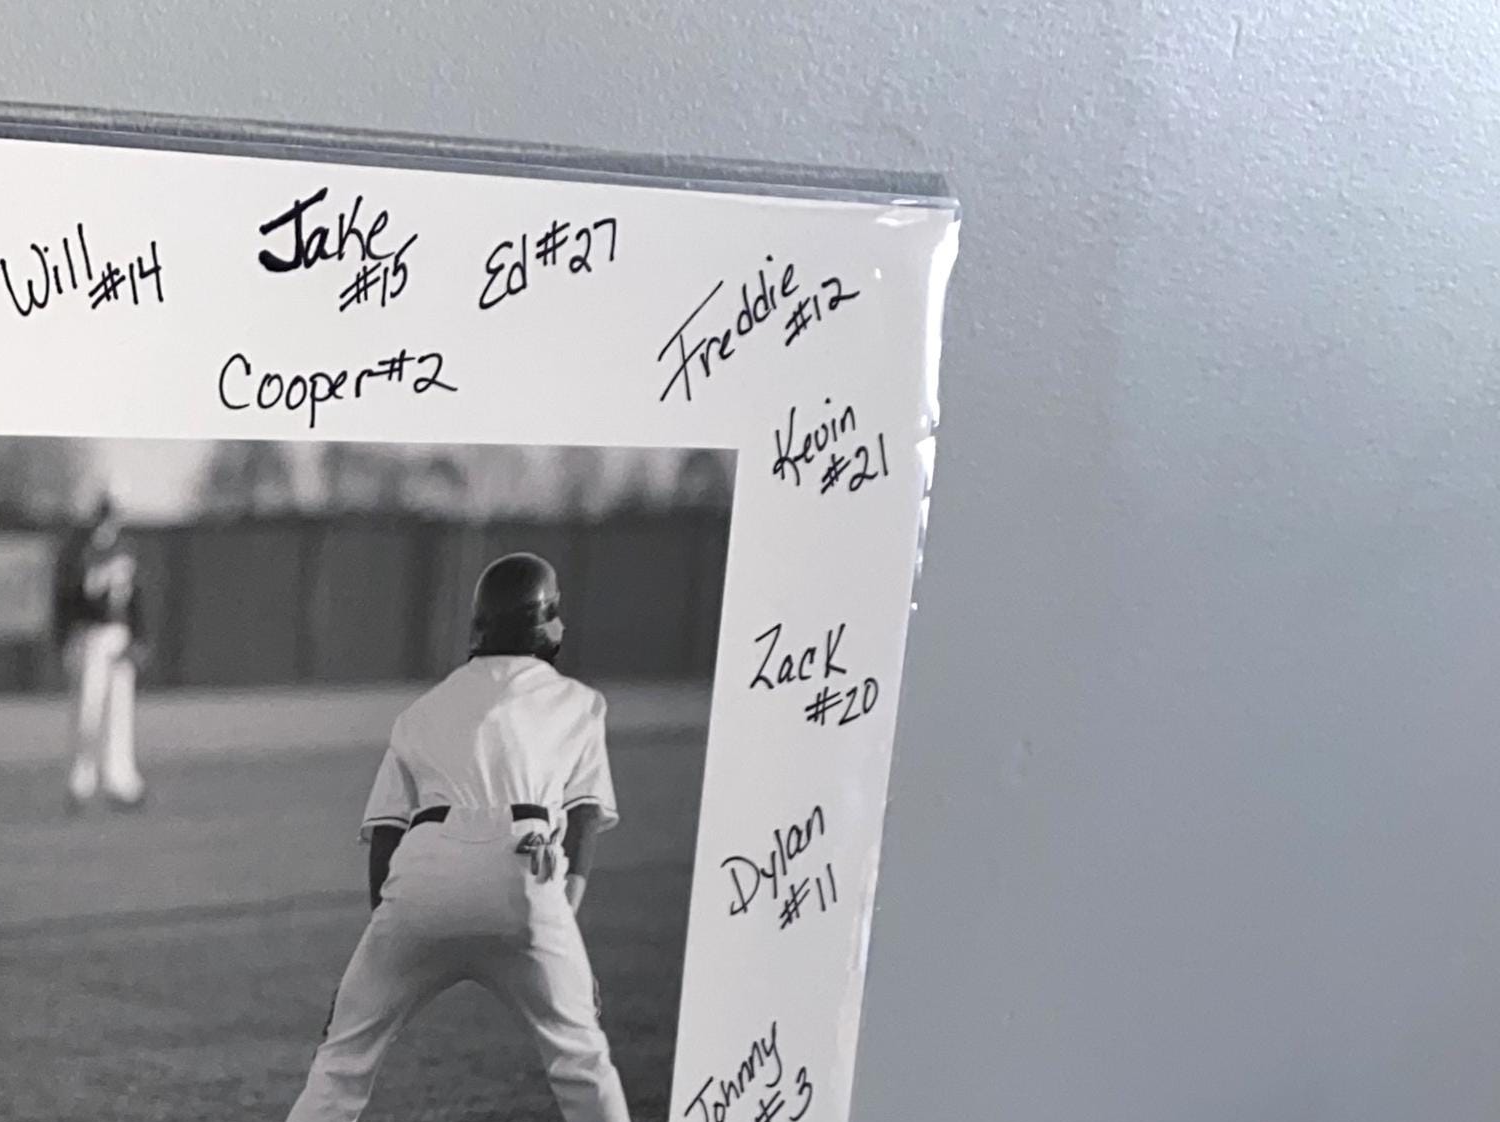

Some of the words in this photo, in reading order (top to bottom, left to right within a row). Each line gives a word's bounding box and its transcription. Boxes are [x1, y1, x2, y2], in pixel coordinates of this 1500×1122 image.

[258, 187, 395, 273] Jake
[338, 232, 419, 313] #15
[655, 253, 801, 404] Freddie
[783, 275, 862, 349] #12
[770, 396, 857, 487] Kevin
[818, 431, 890, 497] #21
[748, 621, 849, 691] Zack
[802, 675, 880, 728] #20
[719, 803, 828, 918] Dylan
[777, 861, 839, 932] #11
